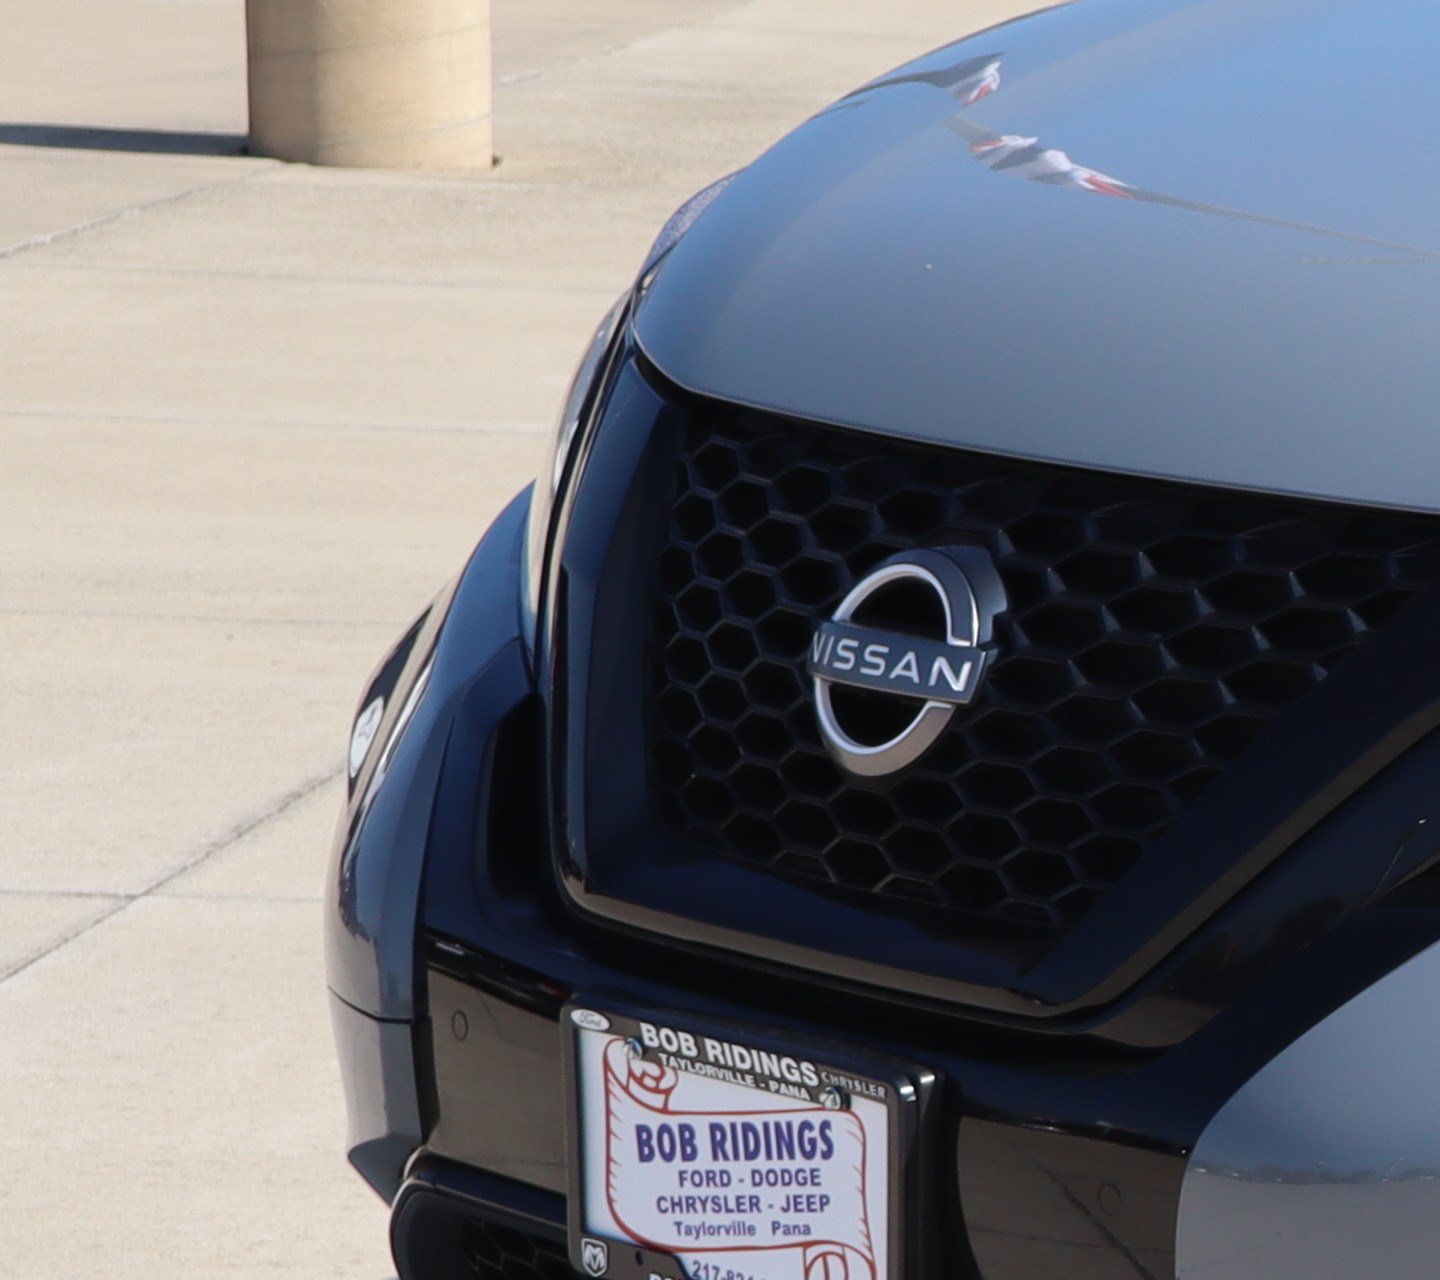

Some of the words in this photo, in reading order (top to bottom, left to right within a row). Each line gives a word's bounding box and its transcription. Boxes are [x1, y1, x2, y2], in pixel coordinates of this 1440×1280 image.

[811, 630, 972, 693] NISSAN
[639, 1022, 698, 1058] BOB
[703, 1038, 820, 1087] RIDINGS
[658, 1052, 756, 1088] TAYLORVILLE
[768, 1080, 812, 1101] PANA
[820, 1071, 887, 1099] CHRYSLER
[634, 1122, 699, 1163] BOB
[708, 1119, 835, 1162] RIDINGS
[678, 1169, 732, 1188] FORD
[750, 1167, 822, 1188] DODGE
[656, 1194, 762, 1214] CHRYSLER
[780, 1193, 830, 1214] JEEP
[673, 1220, 757, 1241] Taylorville
[770, 1220, 812, 1236] Pana
